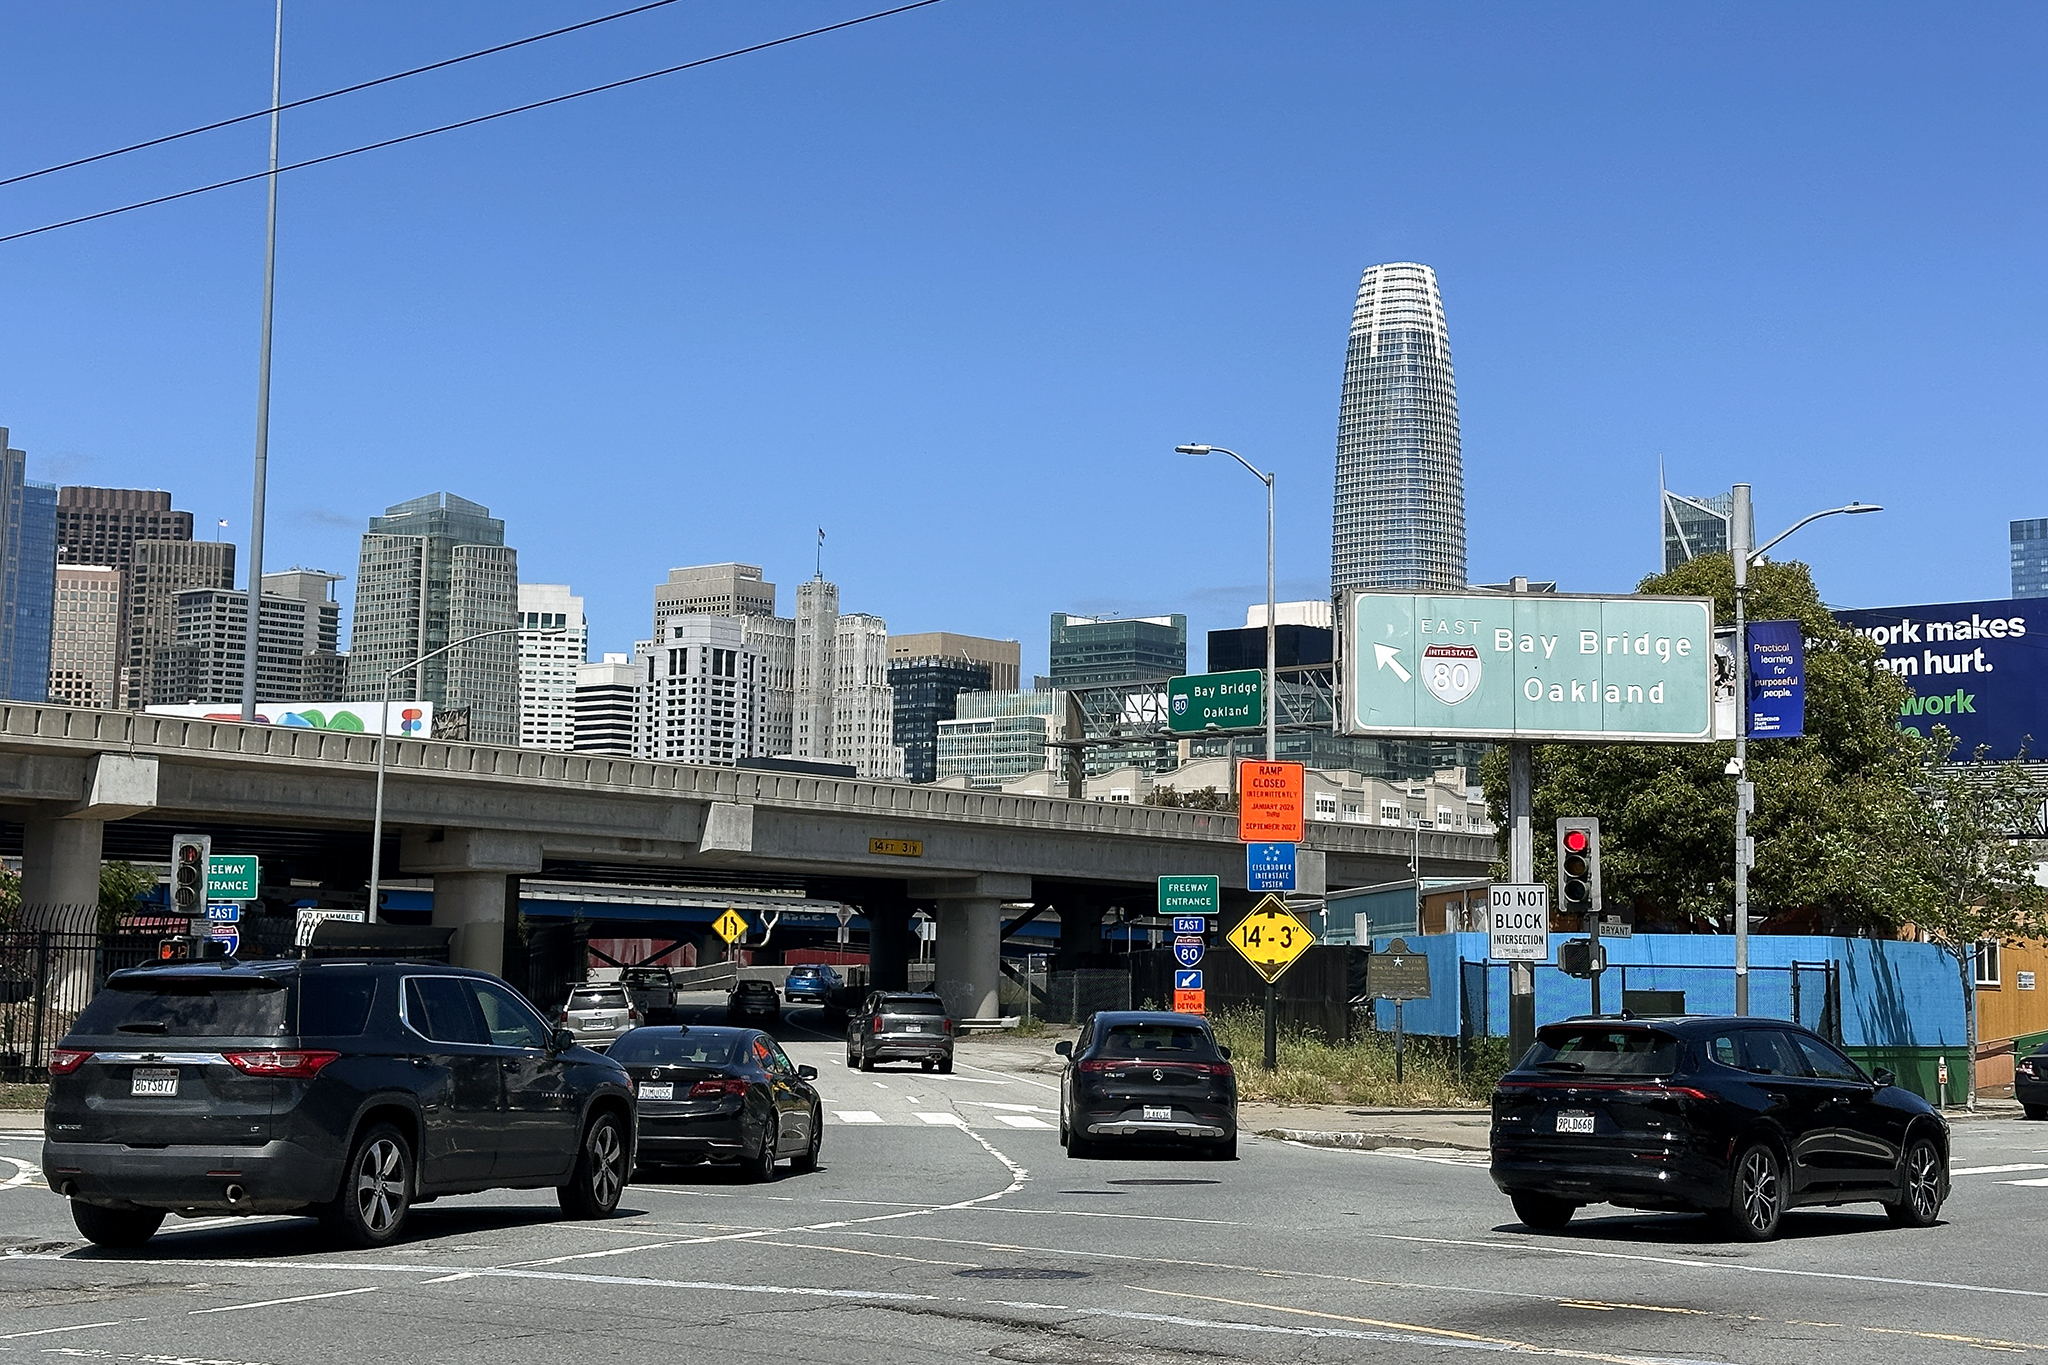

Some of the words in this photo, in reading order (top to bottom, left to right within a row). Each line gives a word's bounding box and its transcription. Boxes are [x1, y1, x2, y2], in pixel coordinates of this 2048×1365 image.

[1421, 619, 1481, 635] EAST
[1926, 614, 2026, 642] makes
[1494, 628, 1558, 660] Bay
[1579, 630, 1692, 664] Bridge
[1754, 643, 1790, 653] Practical
[1428, 649, 1475, 657] INTERSTATE
[1761, 655, 1793, 665] learning
[1924, 647, 1993, 674] hurt.
[1774, 665, 1786, 674] for
[1433, 662, 1469, 691] 80
[1755, 676, 1798, 687] purposeful
[1194, 686, 1215, 698] Bay
[1220, 683, 1258, 696] Bridge
[1523, 677, 1665, 704] Oakland
[1763, 688, 1793, 698] people.
[1174, 700, 1187, 711] 80
[1900, 688, 1976, 716] work
[1203, 704, 1249, 718] Oakland
[1259, 766, 1283, 775] RAMP
[1252, 778, 1286, 788] CLOSED
[207, 864, 245, 874] EEWAY
[209, 881, 248, 890] TRANCE
[1168, 883, 1208, 892] FREEWAY
[1166, 897, 1211, 906] ENTRANCE
[1492, 891, 1511, 906] DO
[1517, 891, 1544, 907] NOT
[208, 907, 233, 919] EAST
[1178, 920, 1199, 930] EAST
[1495, 913, 1542, 929] BLOCK
[1600, 925, 1630, 936] BRYANT
[1493, 934, 1543, 946] INTERSECTION
[1180, 948, 1198, 960] 80
[1177, 1002, 1203, 1010] DETOUR
